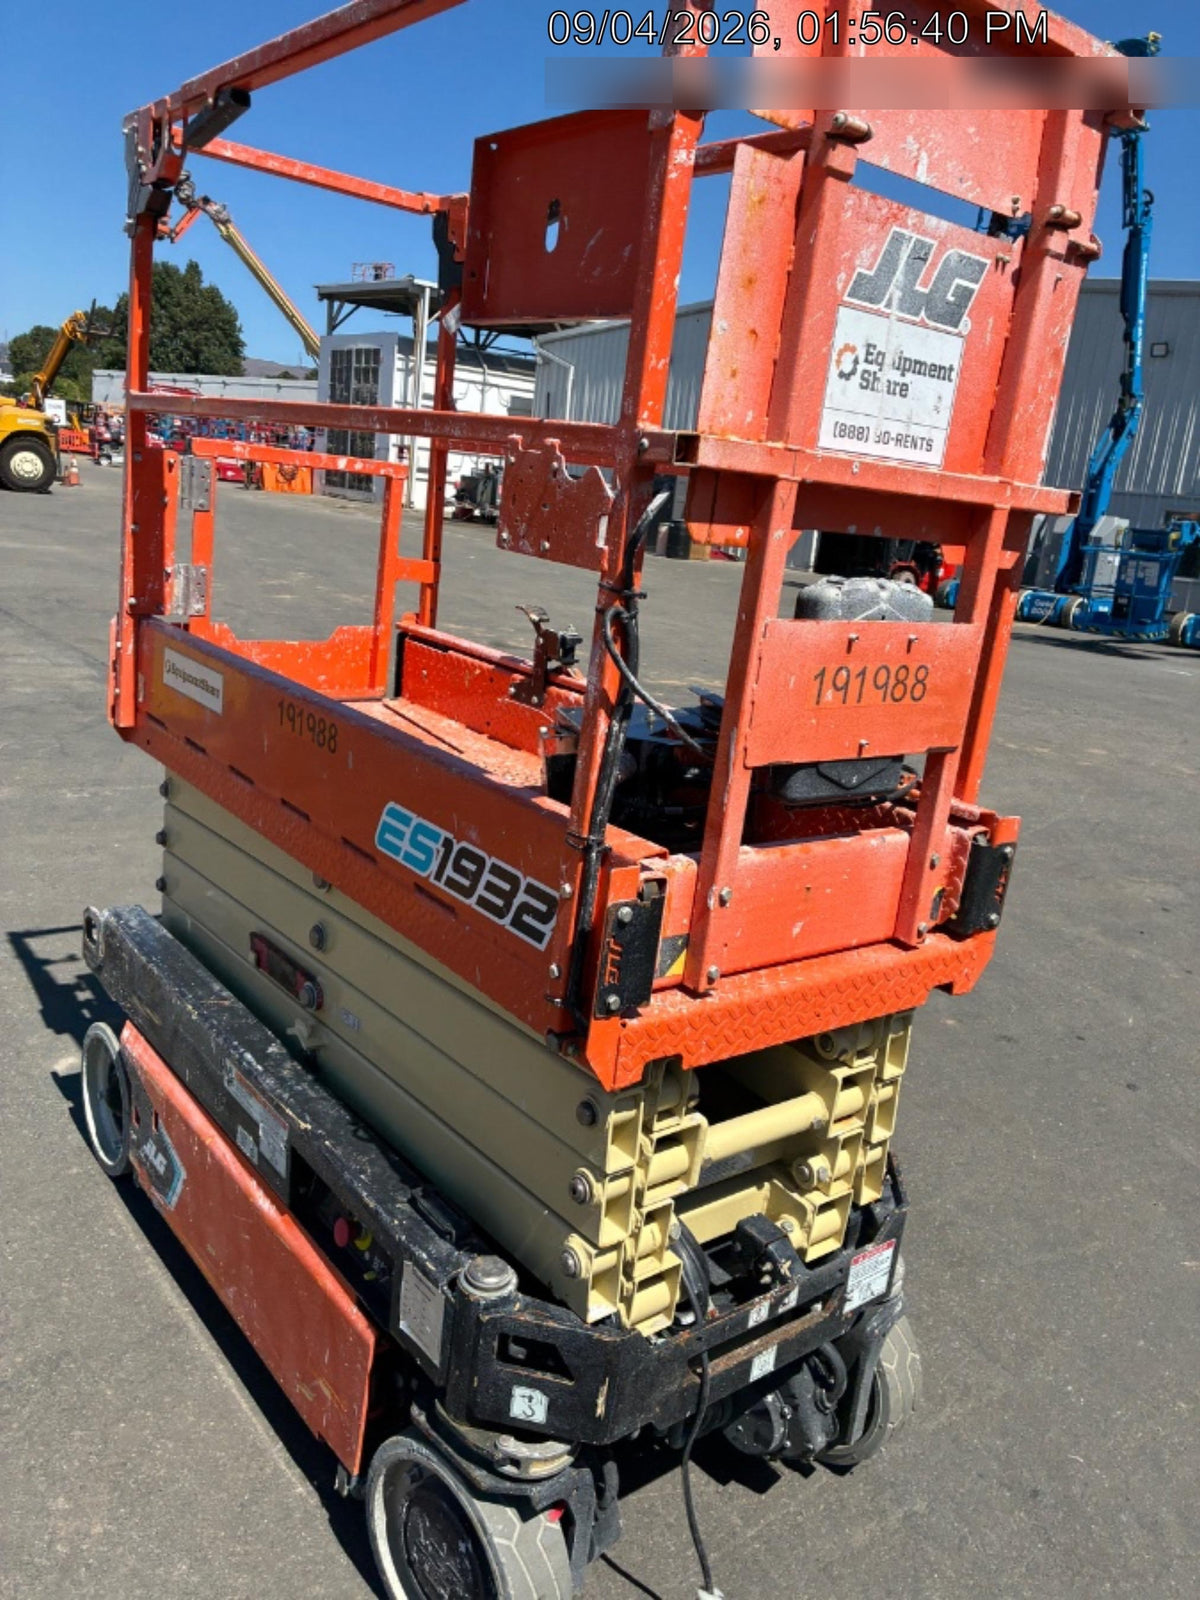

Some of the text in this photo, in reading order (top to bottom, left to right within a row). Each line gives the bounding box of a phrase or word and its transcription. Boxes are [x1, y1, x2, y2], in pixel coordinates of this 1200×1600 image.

[844, 226, 991, 331] JLG
[863, 343, 955, 382] Eqipment
[833, 421, 870, 443] (888)
[814, 664, 929, 705] 191988
[278, 701, 338, 754] 191988
[375, 802, 561, 951] ES1932
